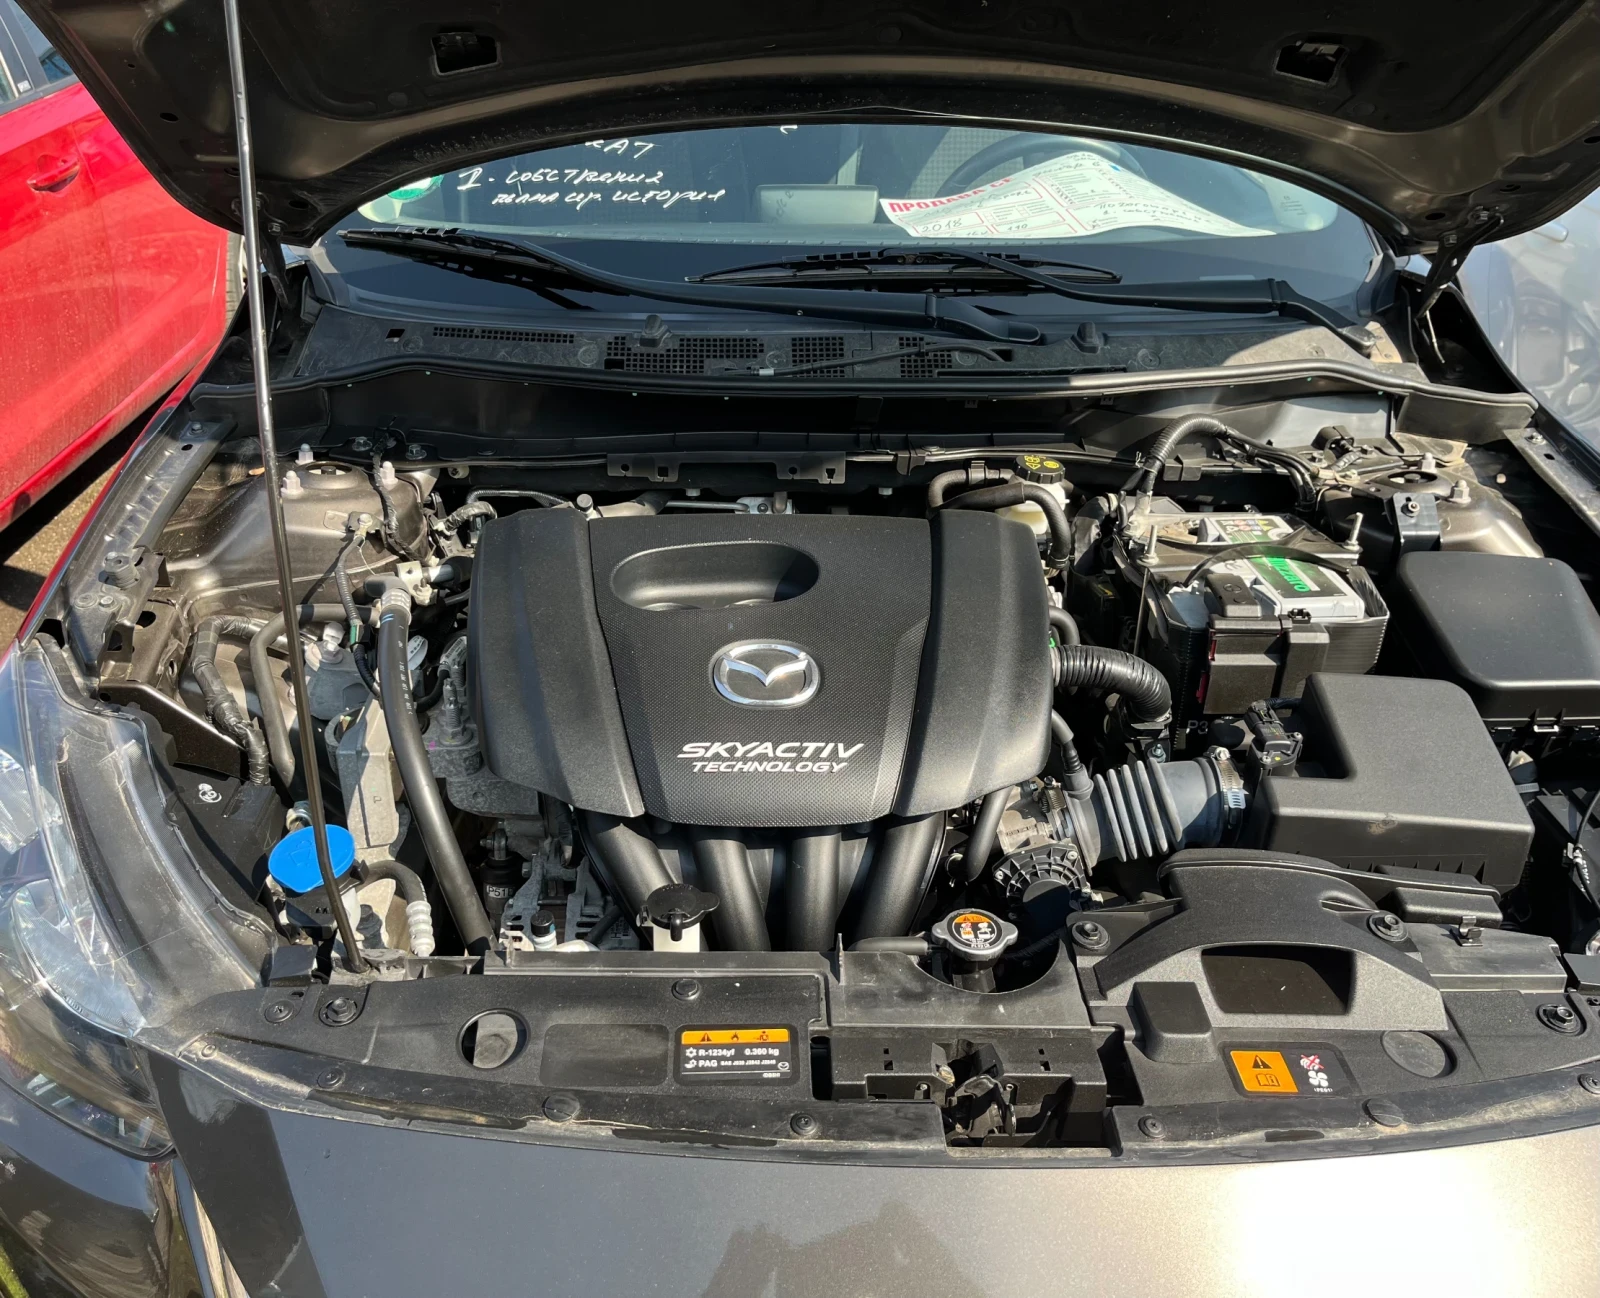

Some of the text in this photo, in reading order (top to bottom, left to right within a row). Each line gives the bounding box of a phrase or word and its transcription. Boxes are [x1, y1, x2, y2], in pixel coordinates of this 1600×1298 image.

[921, 217, 963, 233] 2018
[677, 742, 864, 758] SKYACTIV
[692, 761, 848, 773] TECHNOLOGY
[698, 1048, 735, 1057] R-1234yf
[768, 1047, 780, 1056] kg
[698, 1059, 718, 1067] PAG
